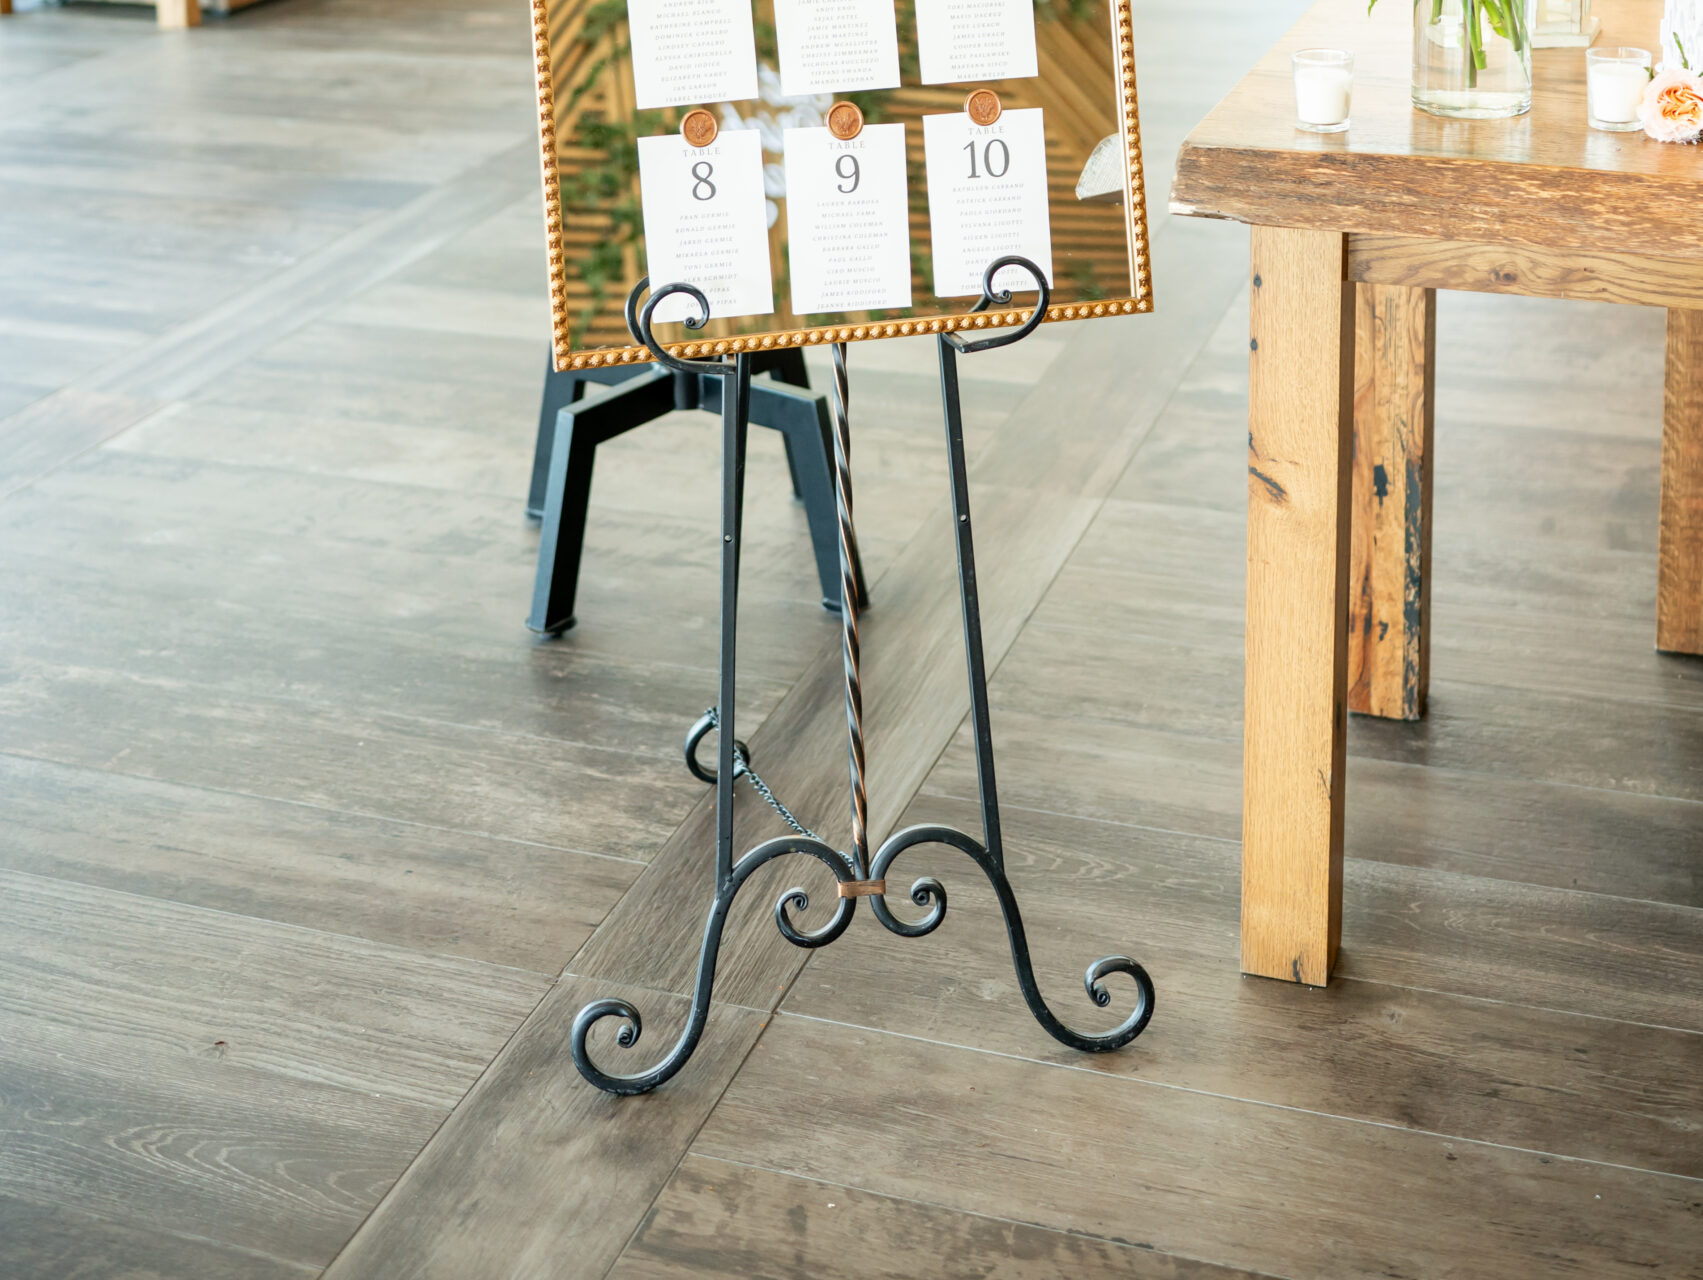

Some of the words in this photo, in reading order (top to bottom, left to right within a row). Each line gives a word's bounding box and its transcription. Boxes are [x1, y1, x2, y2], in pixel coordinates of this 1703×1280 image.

[968, 126, 1005, 135] TABLE
[683, 147, 721, 157] TABLE
[828, 141, 865, 149] TABLE
[963, 139, 1010, 178] 10
[692, 162, 716, 201] 8
[835, 154, 860, 193] 9
